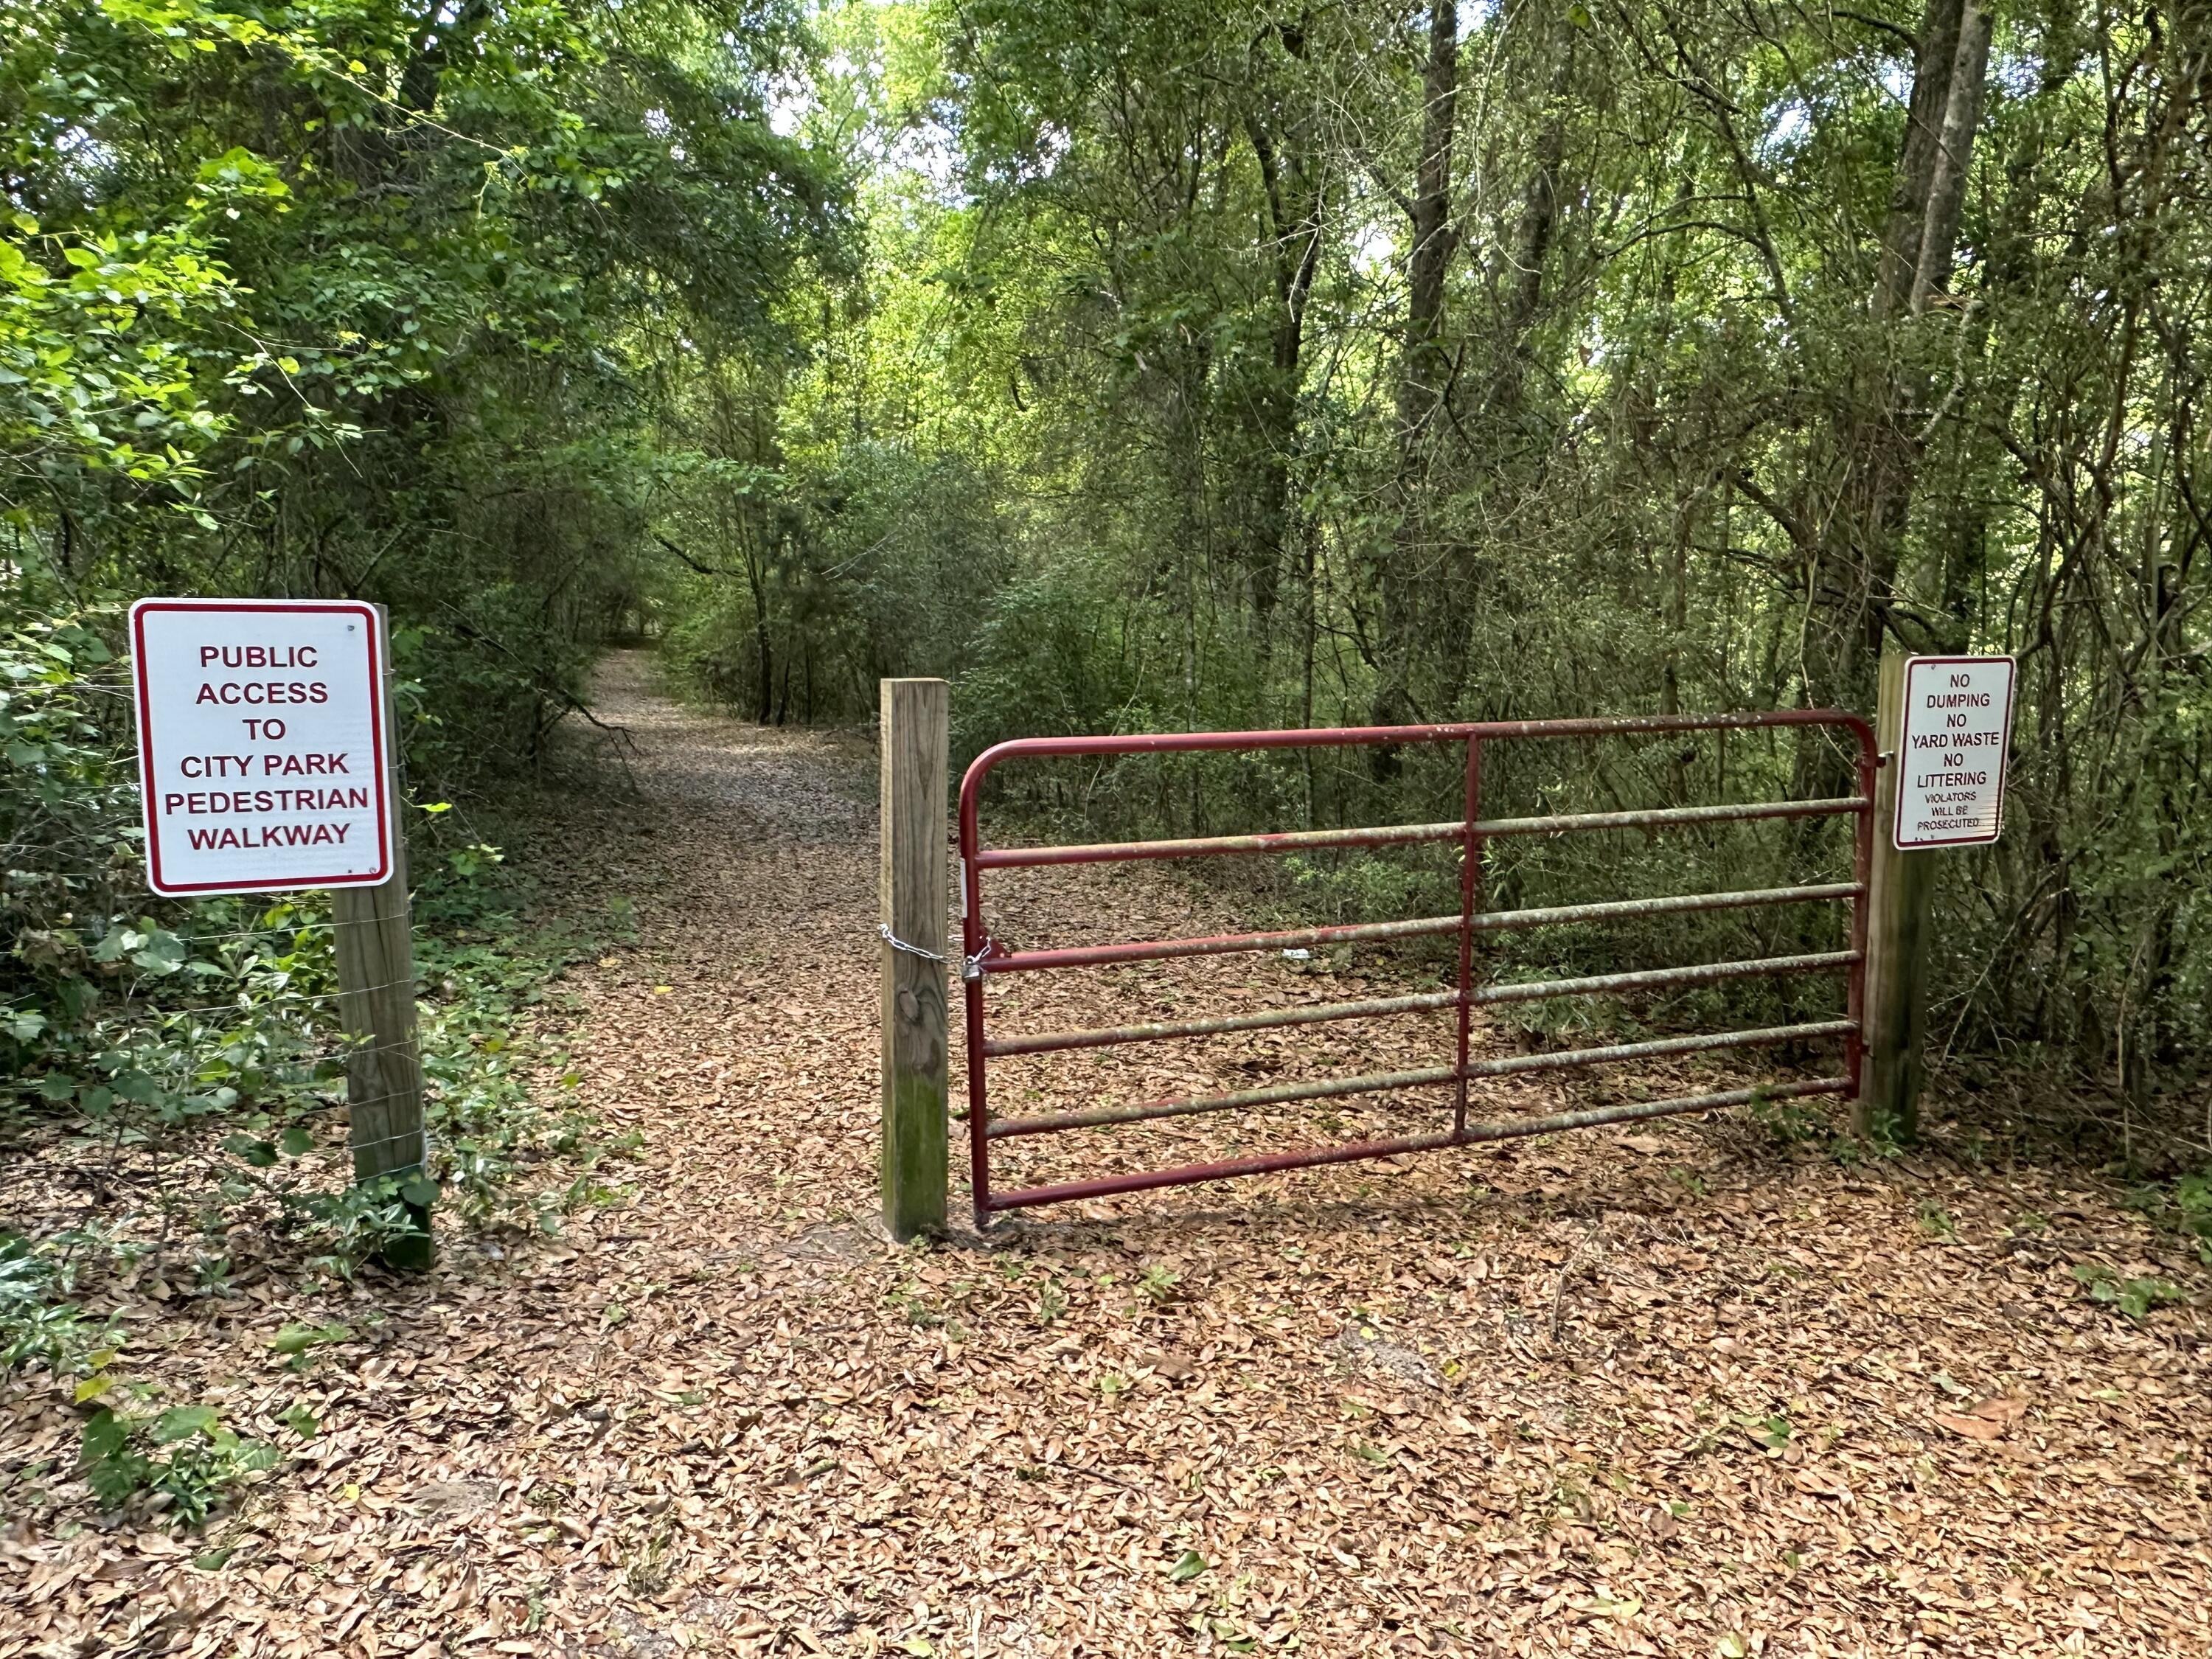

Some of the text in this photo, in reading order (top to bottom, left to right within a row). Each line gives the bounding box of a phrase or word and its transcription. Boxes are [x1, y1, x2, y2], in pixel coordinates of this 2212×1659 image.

[201, 646, 318, 668] PUBLIC
[1950, 674, 1970, 688] NO
[196, 682, 328, 704] ACCESS
[1927, 693, 1990, 709] DUMPING
[243, 718, 286, 740] TO
[1947, 714, 1966, 728] NO
[1912, 731, 1999, 748] YARD WASTE
[181, 753, 349, 777] CITY PARK
[1944, 753, 1964, 767] NO
[1917, 771, 1986, 788] LITTERING
[166, 787, 368, 815] PEDESTRIAN
[1924, 791, 1976, 804] VIOLATORS
[1932, 805, 1968, 816] WILL BE
[1917, 818, 1979, 831] PROSECUTED
[188, 823, 351, 850] WALKWAY
